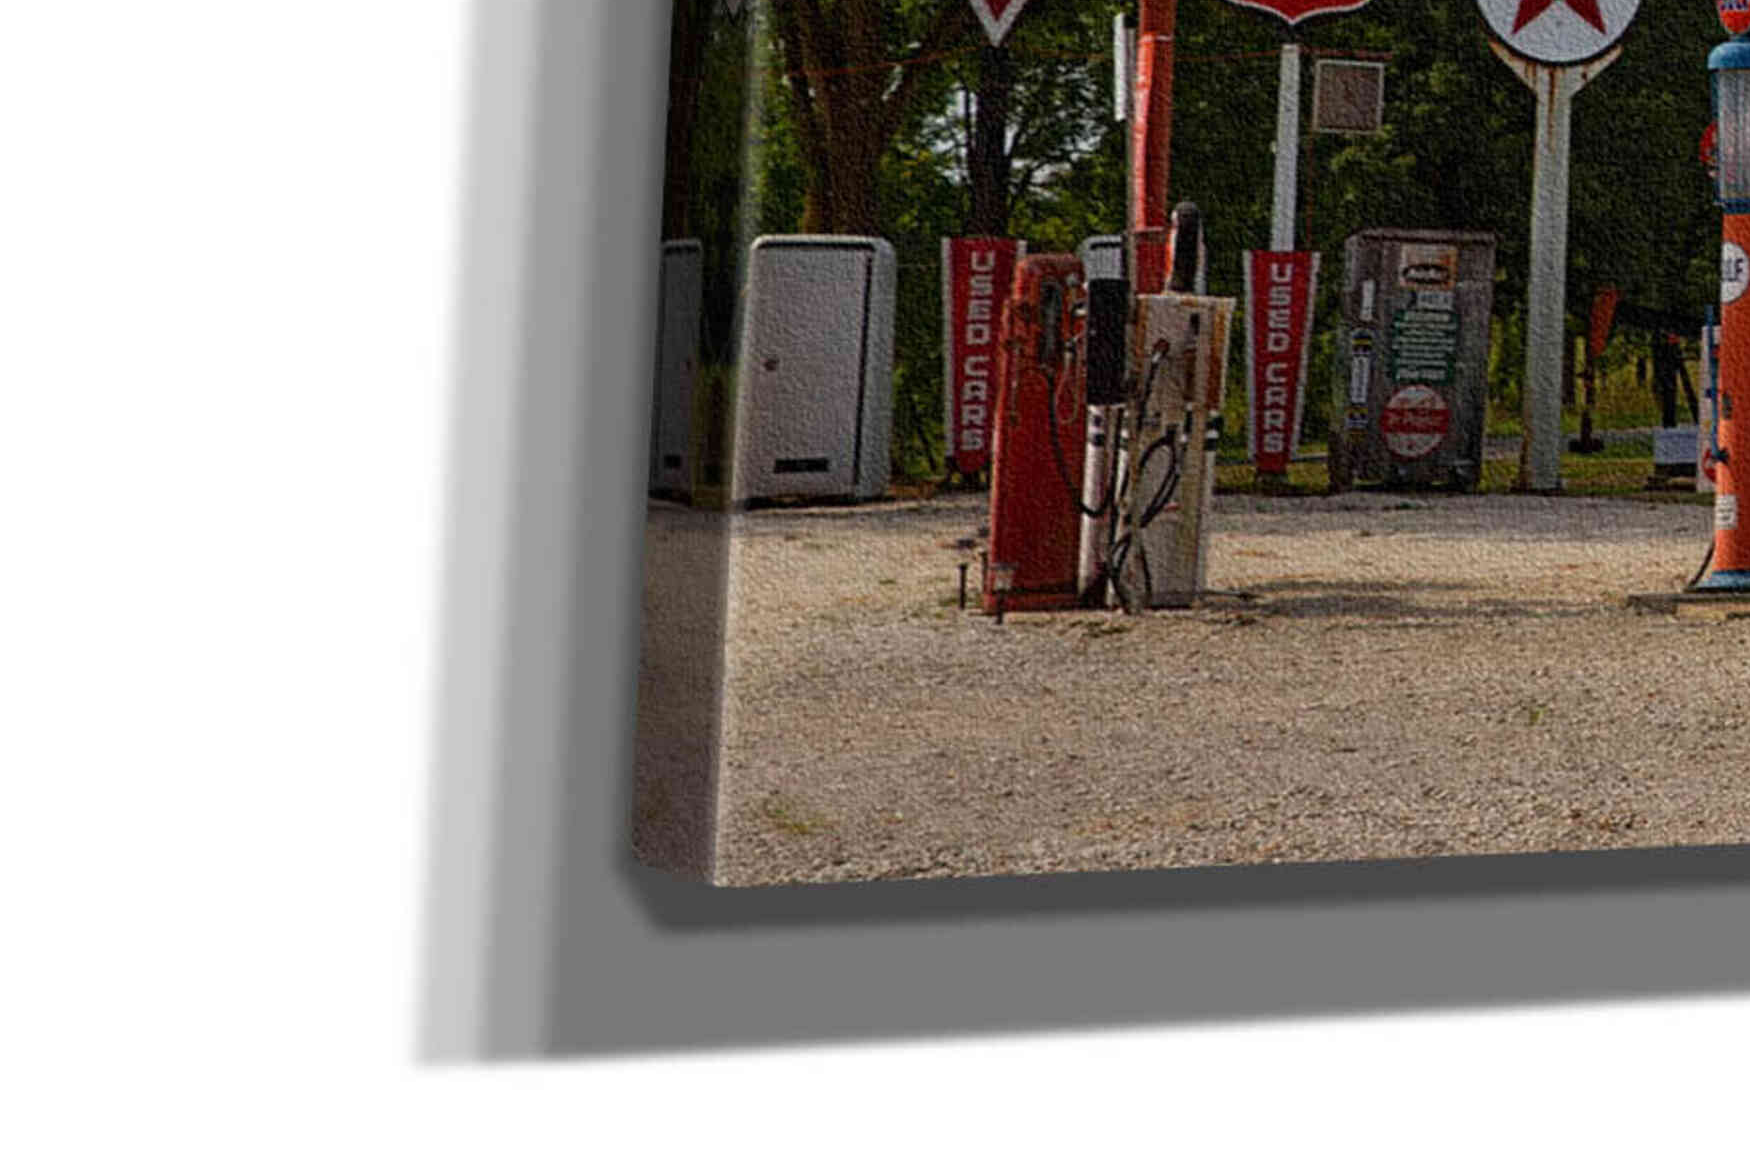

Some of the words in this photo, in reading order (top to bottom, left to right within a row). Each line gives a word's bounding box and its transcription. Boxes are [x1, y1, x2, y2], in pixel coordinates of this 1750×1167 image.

[965, 250, 996, 347] USED
[1265, 262, 1293, 355] USED
[961, 359, 990, 451] CARS
[1262, 366, 1290, 455] CARS
